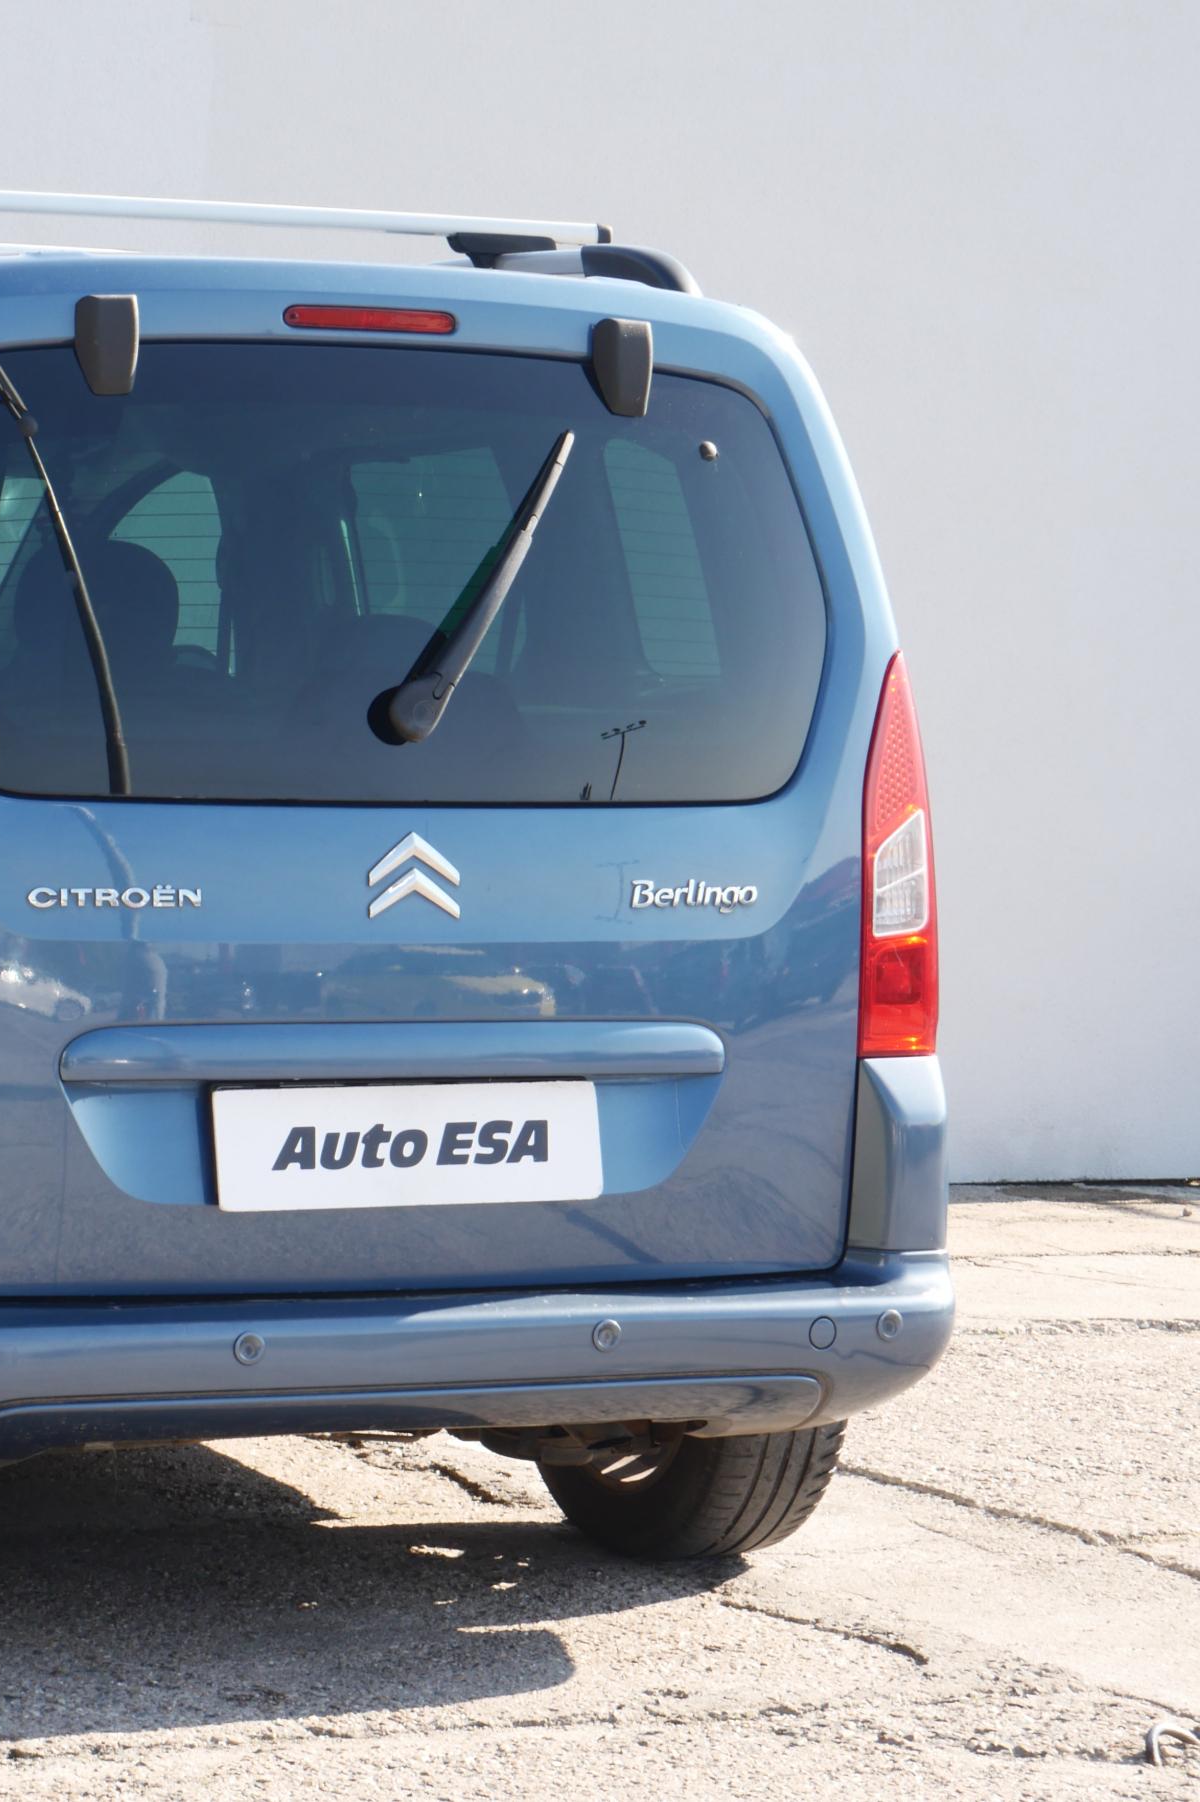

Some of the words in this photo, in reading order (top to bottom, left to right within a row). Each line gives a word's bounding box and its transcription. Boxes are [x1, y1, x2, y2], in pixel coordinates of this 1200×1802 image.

[28, 885, 202, 908] CITROËN
[631, 879, 758, 913] Berlingo
[272, 1124, 428, 1170] Auto
[436, 1120, 548, 1165] ESA
